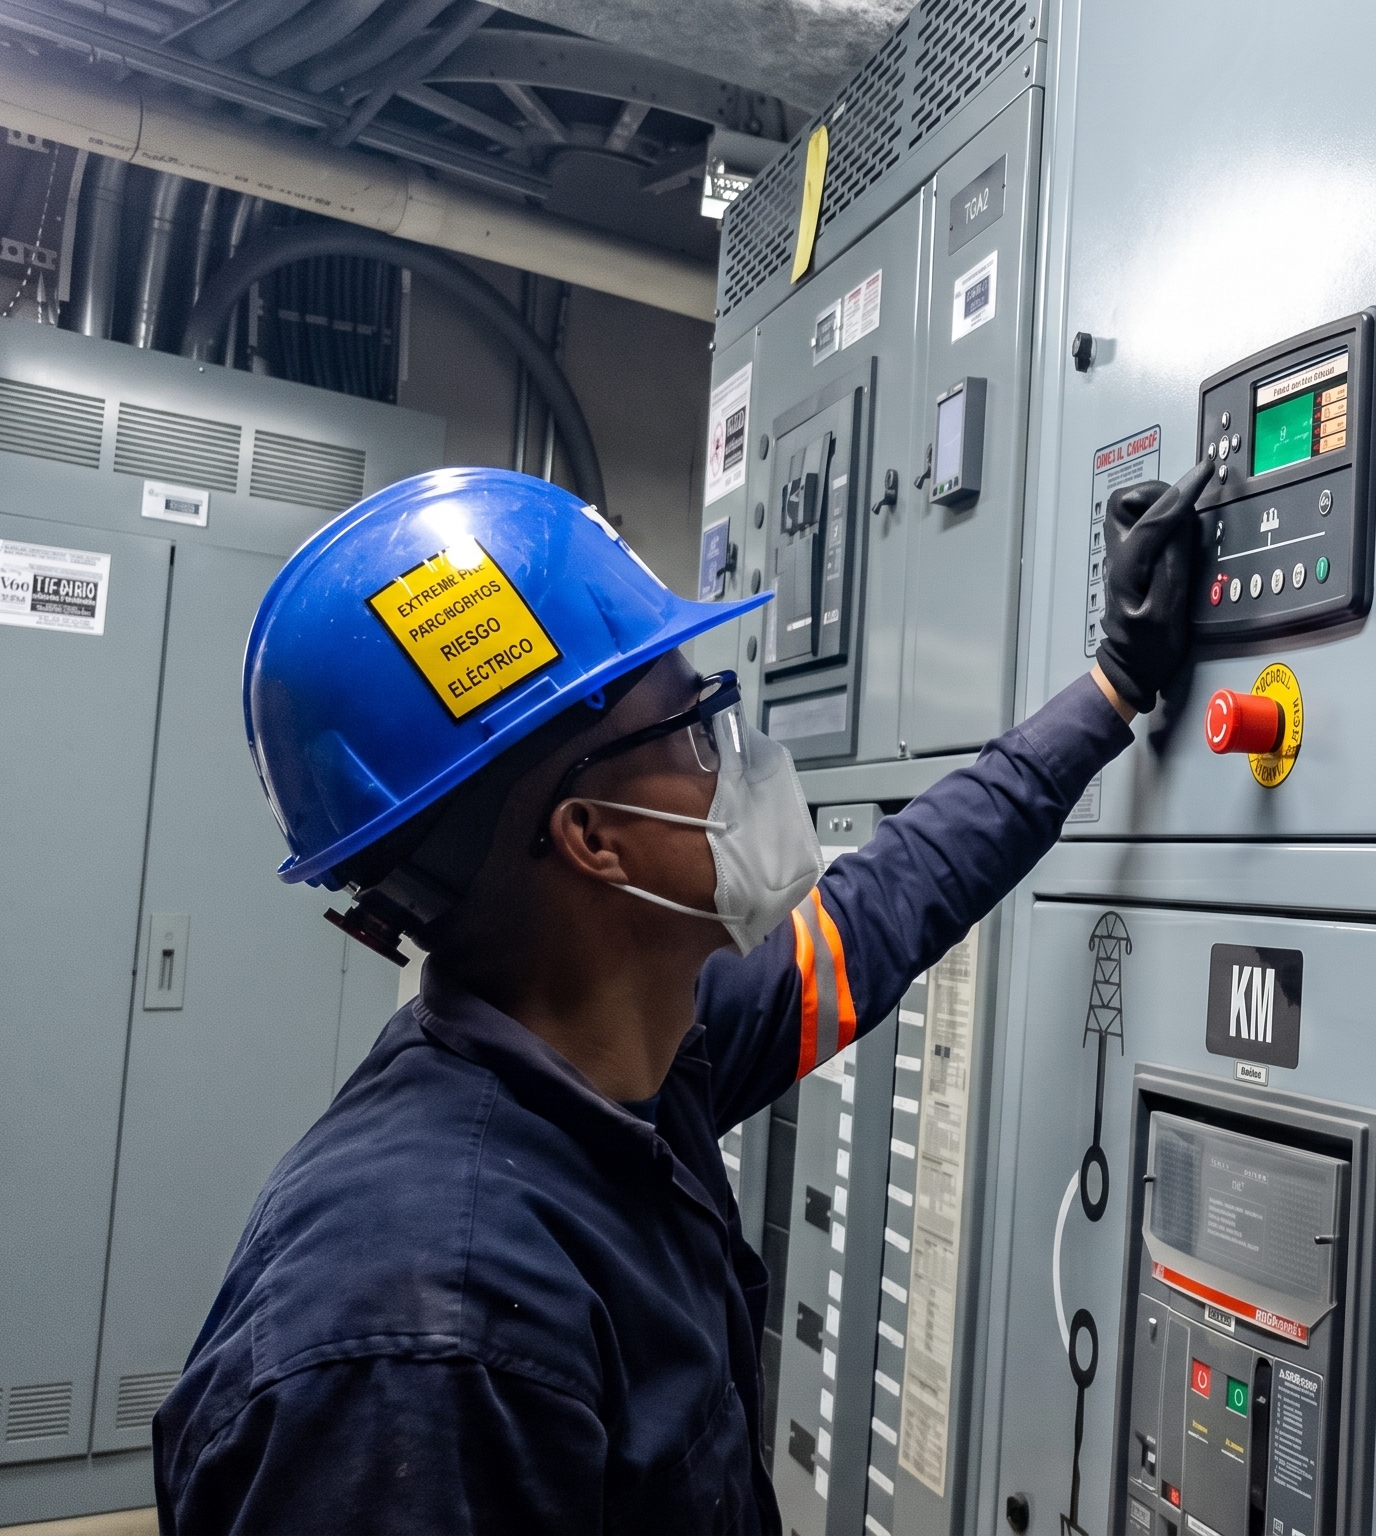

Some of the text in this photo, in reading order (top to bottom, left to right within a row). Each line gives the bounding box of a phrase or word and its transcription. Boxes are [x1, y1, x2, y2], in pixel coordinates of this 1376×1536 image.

[964, 187, 989, 224] TGA2
[439, 617, 501, 662] RIESGO
[447, 637, 534, 699] ELÉCTRICO
[1229, 964, 1276, 1044] KM
